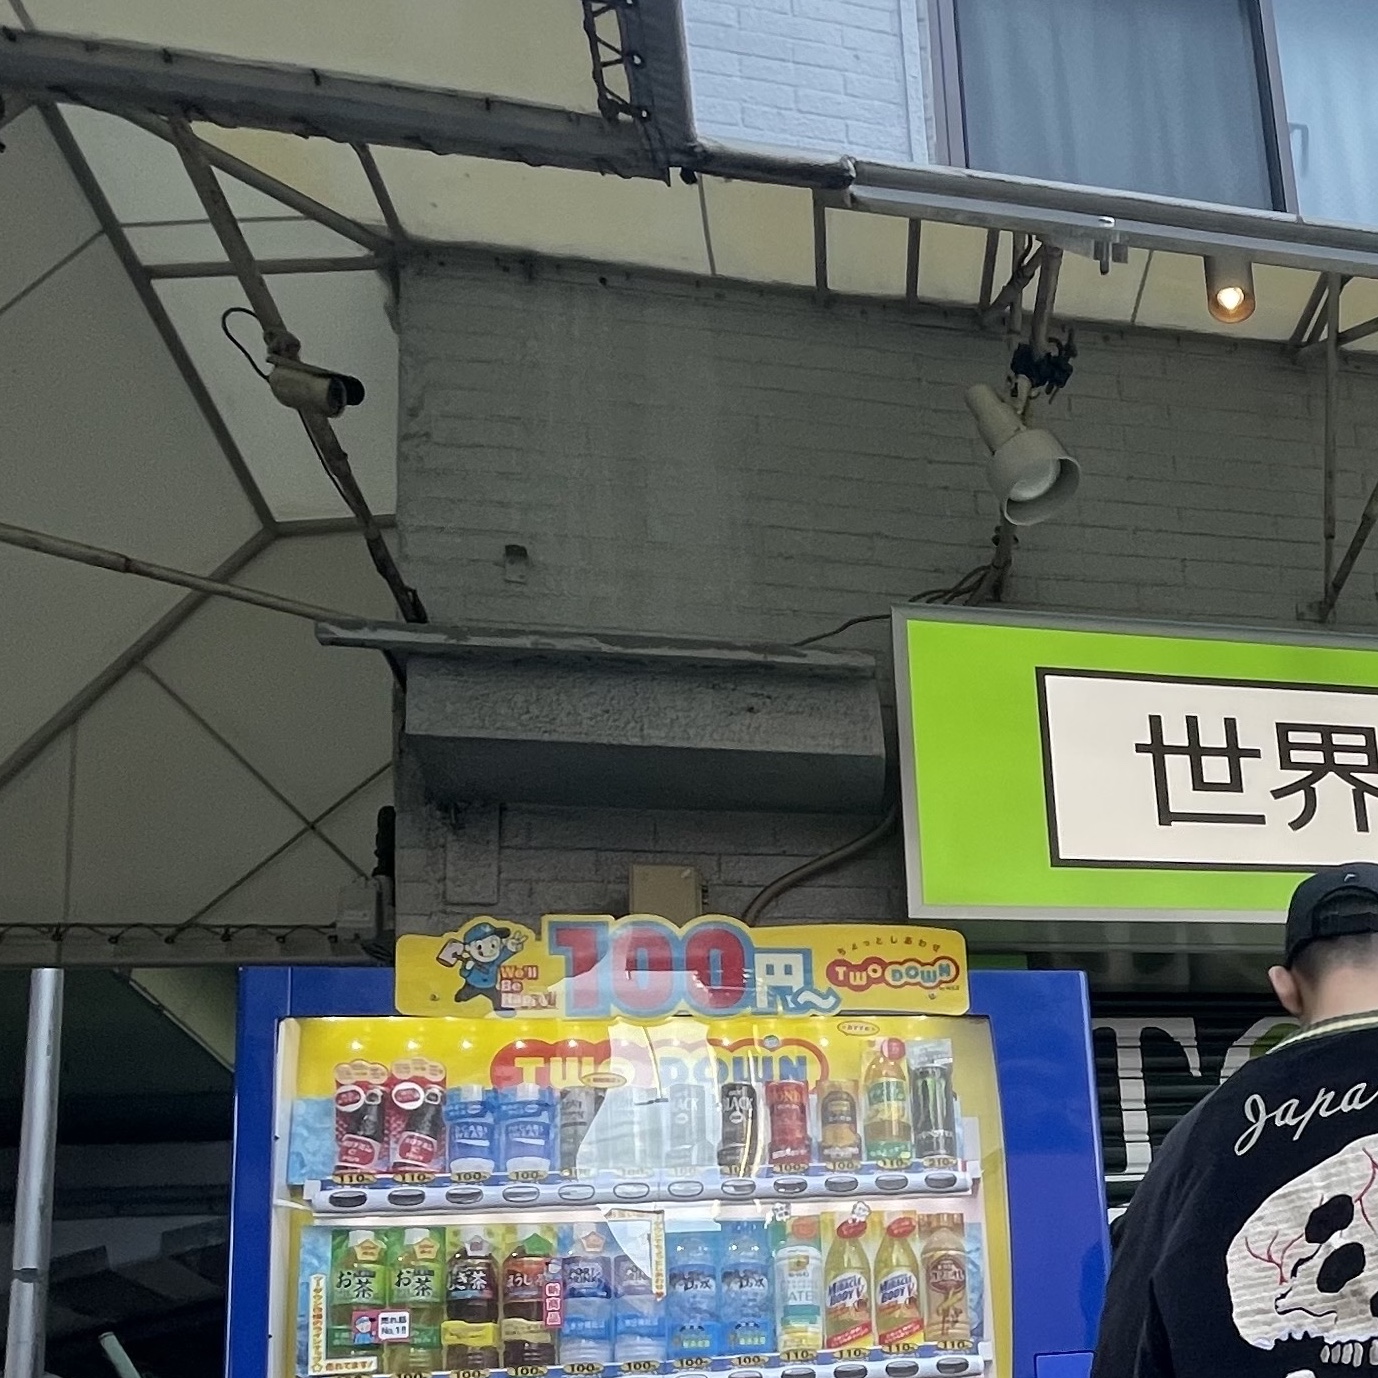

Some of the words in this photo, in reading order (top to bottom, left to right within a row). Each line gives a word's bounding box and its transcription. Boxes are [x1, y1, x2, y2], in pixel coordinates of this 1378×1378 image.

[835, 962, 883, 986] TWO
[891, 962, 951, 983] DOWN
[657, 1055, 808, 1087] DOWN
